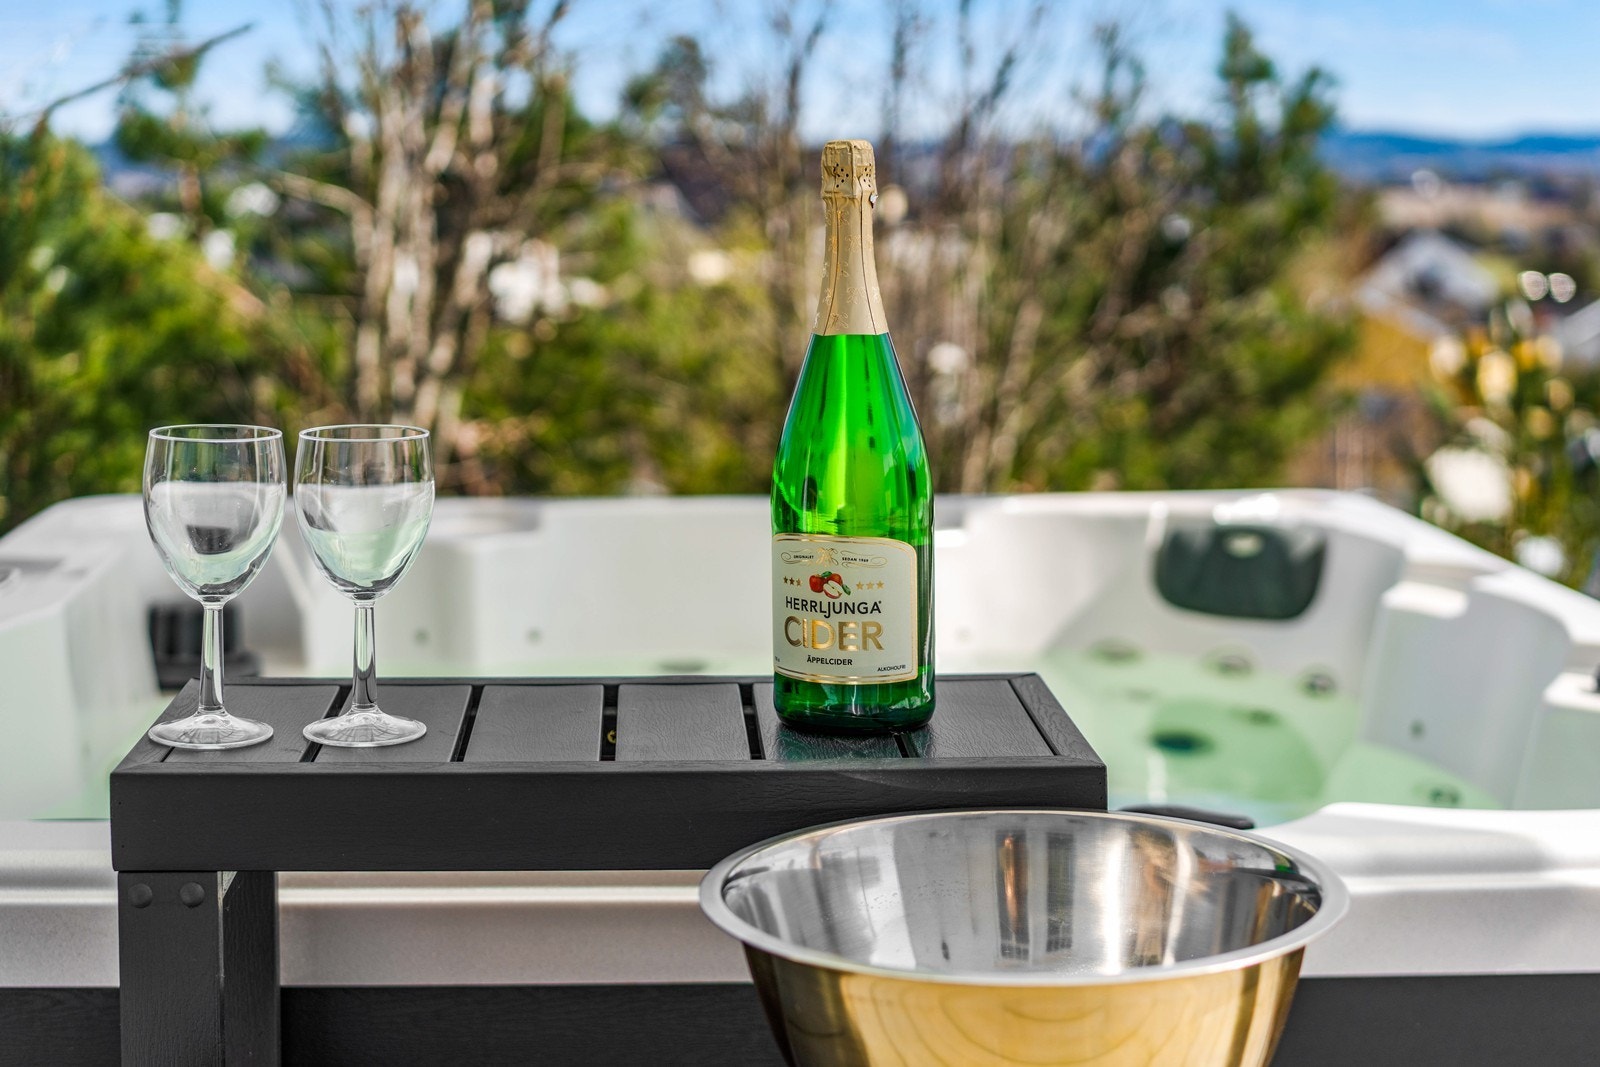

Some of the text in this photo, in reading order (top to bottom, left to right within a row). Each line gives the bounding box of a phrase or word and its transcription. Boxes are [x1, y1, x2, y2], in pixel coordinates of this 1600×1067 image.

[785, 596, 882, 619] HERRLJUNGA
[784, 615, 885, 651] CIDER
[806, 655, 853, 666] ÄPPELCIDER
